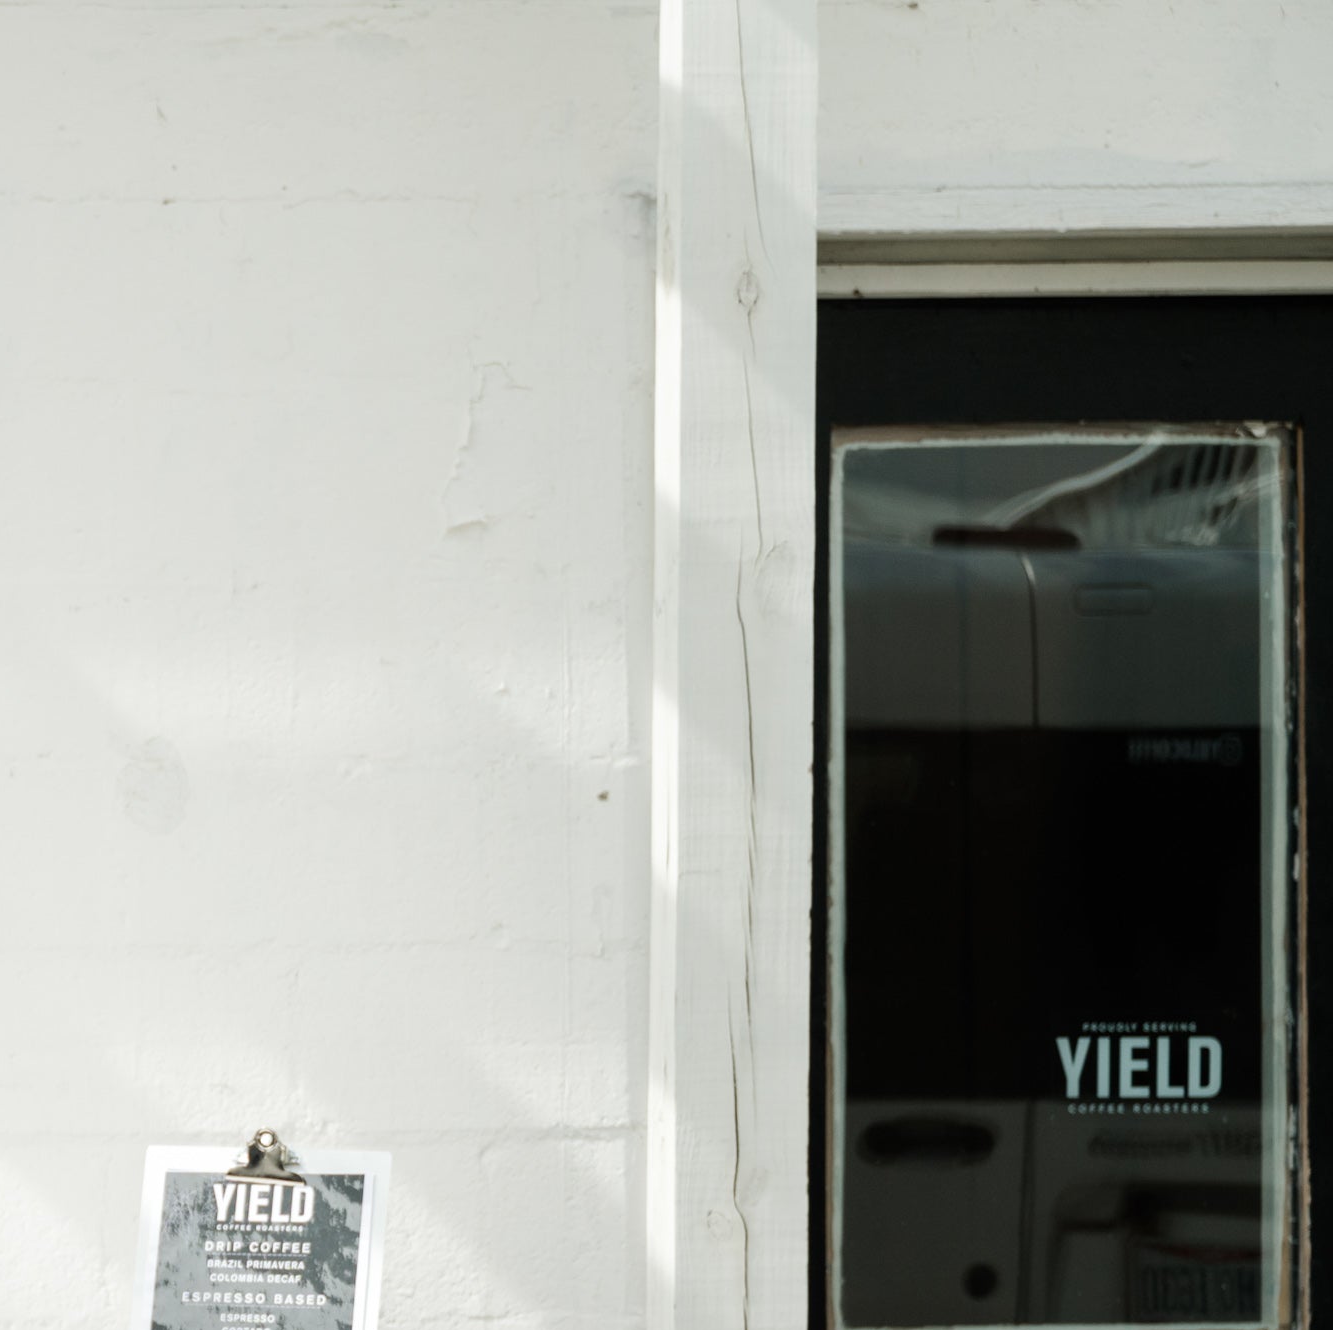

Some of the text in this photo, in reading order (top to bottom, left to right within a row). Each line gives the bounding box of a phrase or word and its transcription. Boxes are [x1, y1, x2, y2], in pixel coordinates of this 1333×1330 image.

[1082, 1022, 1197, 1033] PROUDLY SERVING
[1055, 1036, 1223, 1099] YIELD
[1067, 1103, 1210, 1114] COFFEE ROASTERS
[212, 1183, 315, 1223] YIELD
[255, 1224, 304, 1232] ROASTERS
[204, 1240, 312, 1254] DRIP COFFEE
[207, 1259, 305, 1270] BRAZIL PRIMAVERA
[209, 1273, 302, 1284] COLOMBIA DECAF
[182, 1291, 327, 1306] ESPRESSO BASED
[220, 1313, 276, 1323] ESPRESSO
